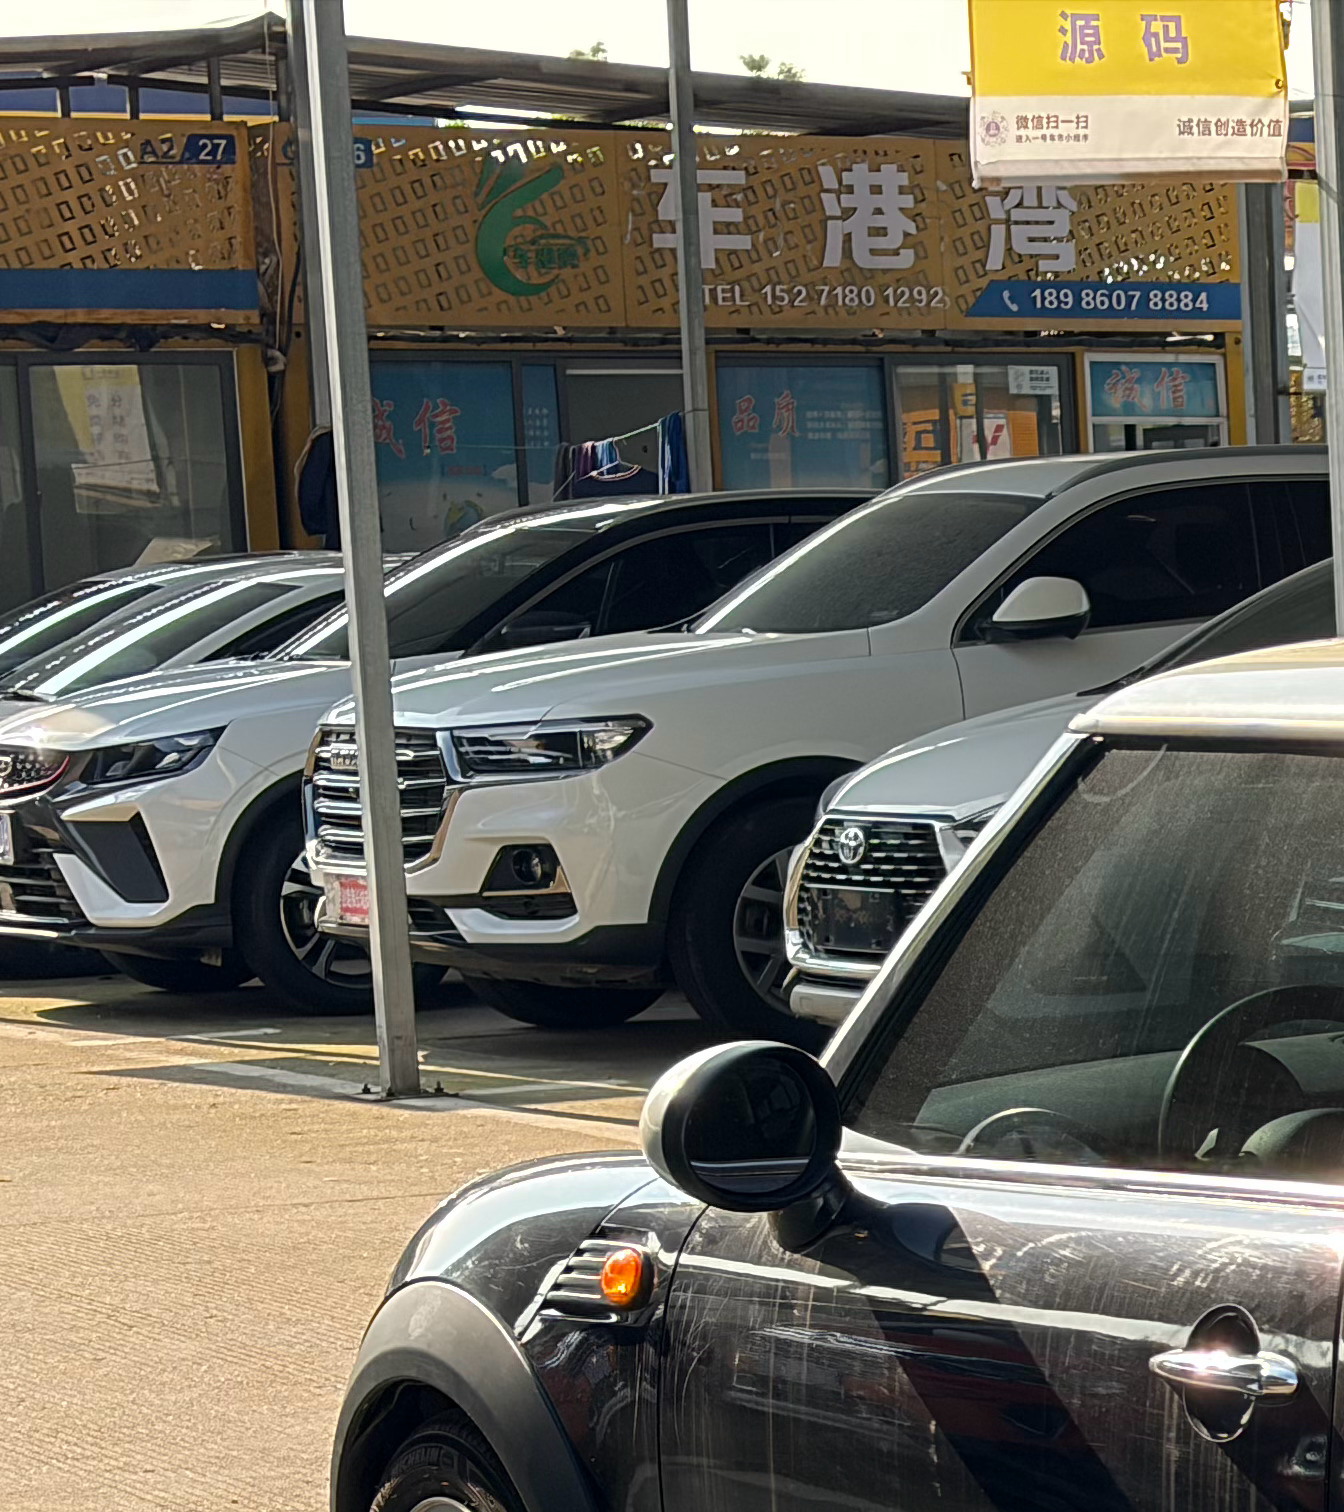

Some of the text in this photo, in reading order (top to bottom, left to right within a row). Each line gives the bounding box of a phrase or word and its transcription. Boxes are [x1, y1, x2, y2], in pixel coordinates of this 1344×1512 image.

[1058, 10, 1189, 65] 源码
[1015, 113, 1089, 131] 微信扫一扫
[1176, 117, 1284, 138] 诚信创造价值
[198, 138, 227, 161] 27
[650, 162, 1077, 272] 车港湾
[702, 284, 934, 308] TEL 152 7180 1292
[1031, 288, 1209, 312] 189 8607 8884
[1104, 366, 1191, 412] 诚信
